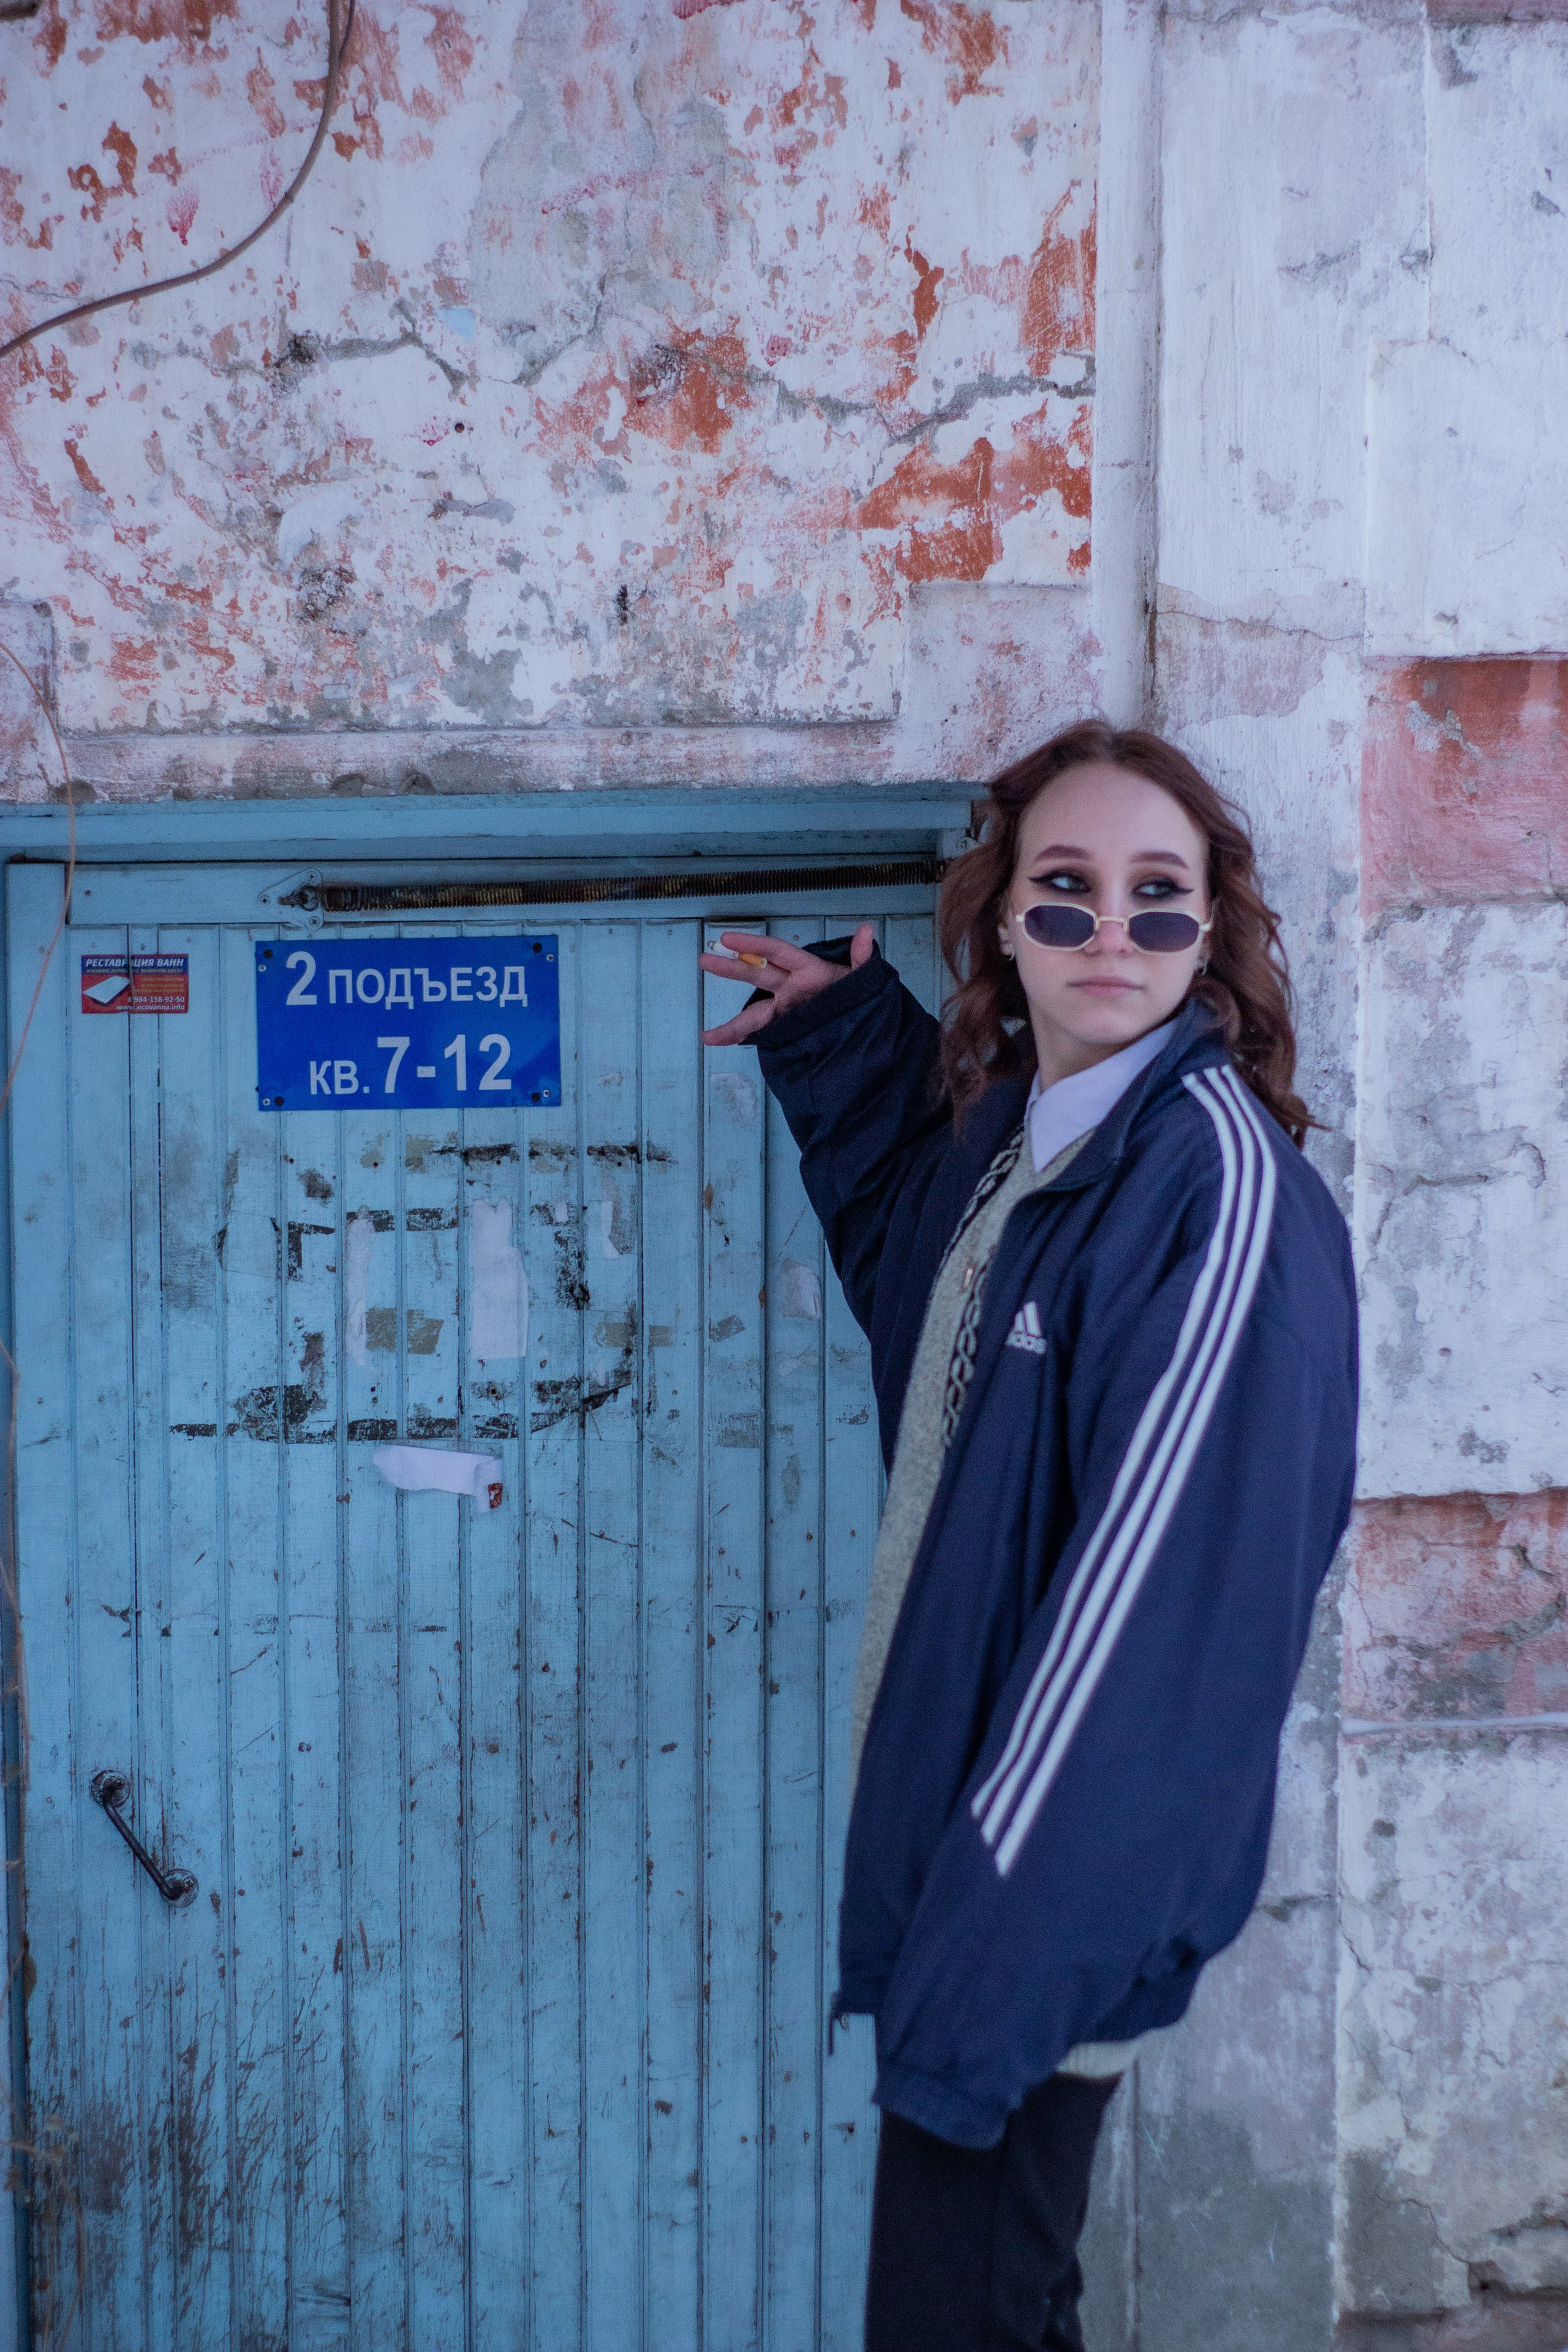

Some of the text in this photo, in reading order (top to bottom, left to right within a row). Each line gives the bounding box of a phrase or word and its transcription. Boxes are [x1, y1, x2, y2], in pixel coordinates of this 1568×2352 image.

[285, 951, 528, 1010] 2 ПОДЪЕЗД
[377, 1033, 511, 1093] 7-12
